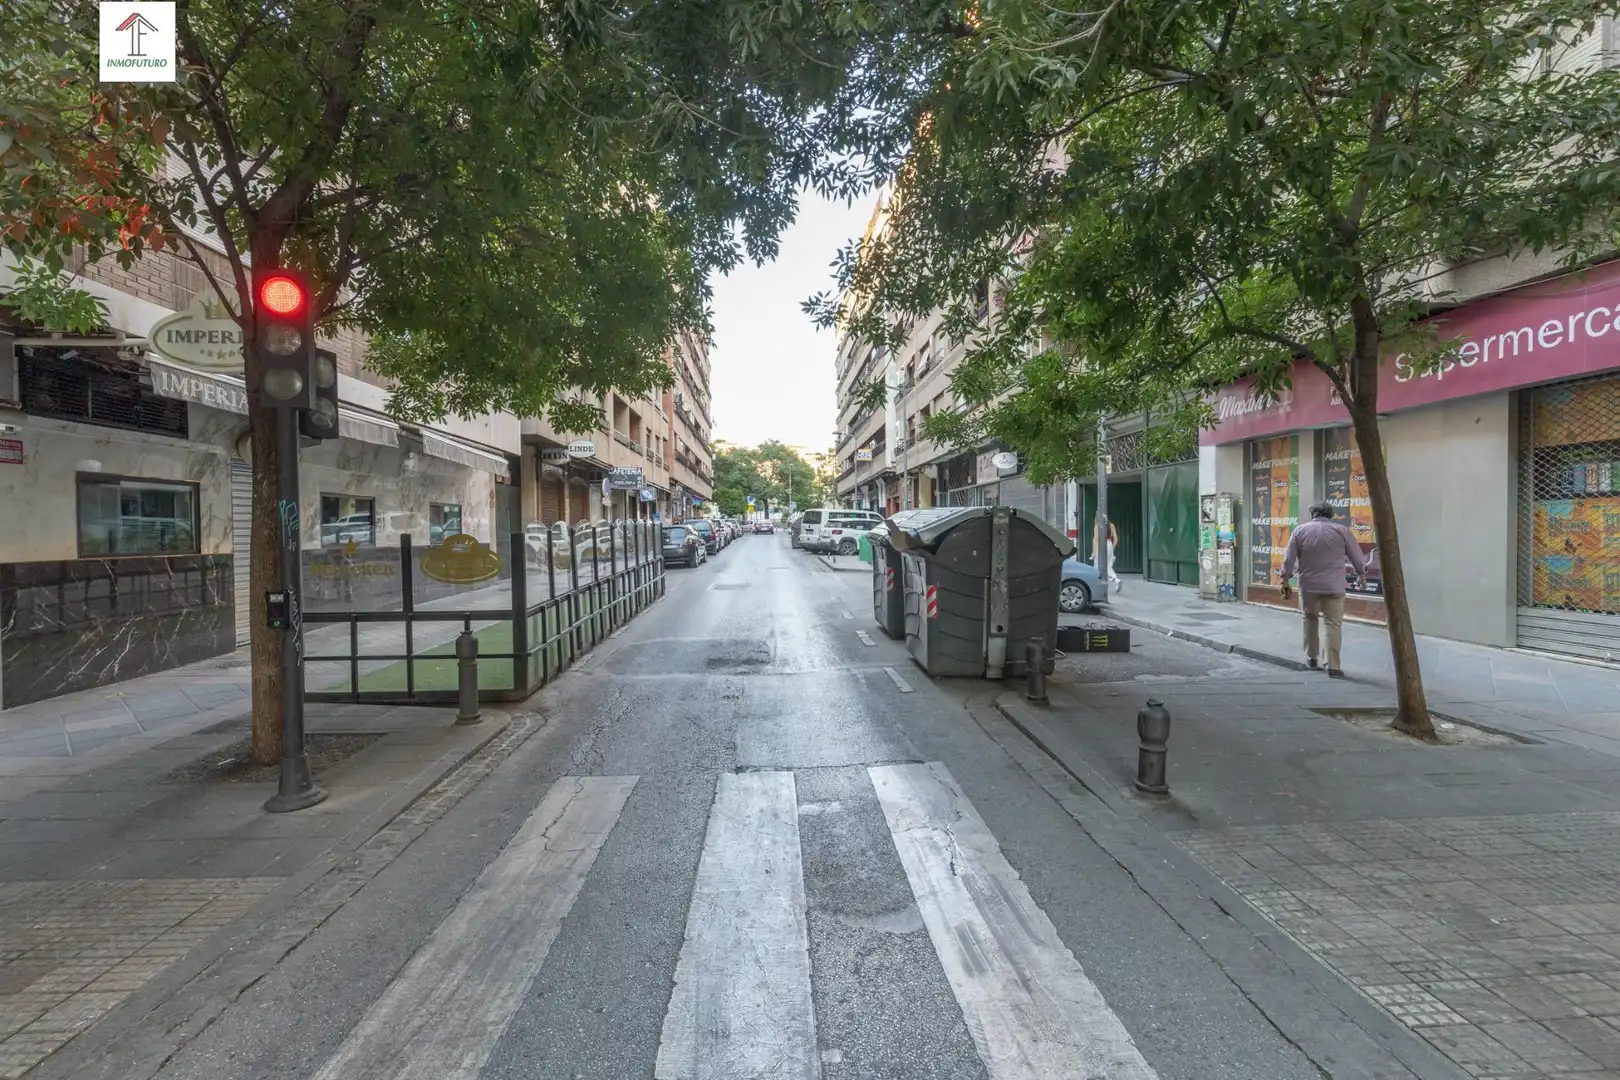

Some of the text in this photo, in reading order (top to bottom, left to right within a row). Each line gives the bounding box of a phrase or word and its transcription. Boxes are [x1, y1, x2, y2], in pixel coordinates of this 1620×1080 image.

[1394, 303, 1620, 383] Spermerc
[569, 445, 594, 453] LINDE
[1325, 450, 1350, 461] MAKE
